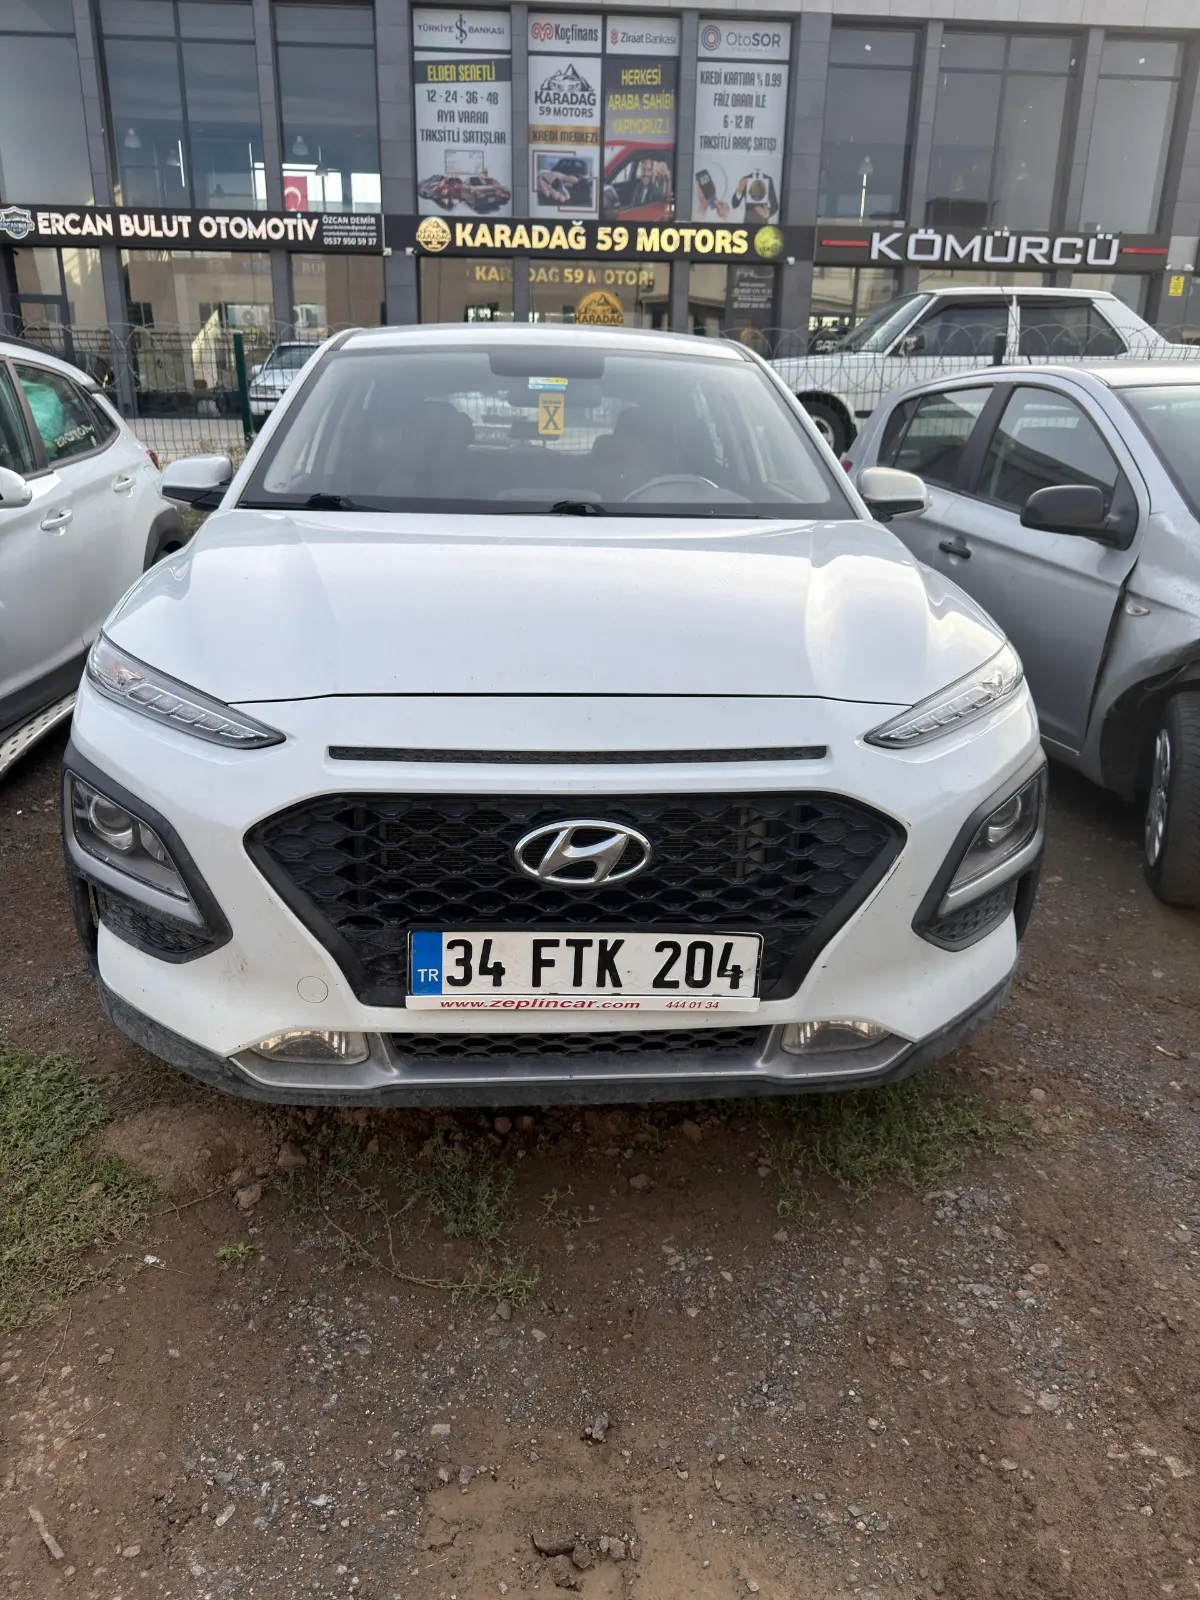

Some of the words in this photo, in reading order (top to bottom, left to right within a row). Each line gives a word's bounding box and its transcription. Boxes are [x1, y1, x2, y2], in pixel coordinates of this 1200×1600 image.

[417, 23, 454, 33] TÜRKİYE
[468, 27, 505, 35] BANKASI
[554, 23, 599, 43] Koçfinans
[620, 33, 644, 44] Ziraat
[645, 33, 676, 44] Bankası
[726, 32, 781, 47] OtoSOR
[427, 65, 456, 81] ELDEN
[621, 64, 662, 86] HERKESİ
[700, 68, 722, 85] KREDİ
[765, 72, 782, 87] 0.99
[426, 89, 437, 103] 12
[445, 90, 458, 103] 24
[466, 91, 478, 104] 36
[486, 92, 499, 105] 48
[608, 94, 640, 110] ARABA
[642, 89, 675, 110] SAHİBİ
[437, 109, 455, 123] AYA
[458, 110, 489, 124] VARAN
[539, 106, 551, 116] 59
[553, 107, 594, 118] MOTORS
[723, 114, 729, 128] 6
[735, 115, 743, 128] 12
[744, 115, 755, 129] AY
[420, 127, 460, 143] TAKSİTLİ
[462, 130, 506, 146] SATIŞLAR
[36, 212, 114, 236] ERCAN
[120, 214, 192, 239] BULUT
[199, 212, 319, 241] OTOMOTİV
[322, 214, 348, 224] ÖZCAN
[350, 215, 376, 225] DEMİR
[323, 236, 341, 245] 0537
[455, 220, 587, 252] KARADAĞ
[596, 226, 629, 252] 59
[636, 227, 749, 254] MOTORS
[870, 228, 1120, 266] KÖMÜRCÜ
[563, 267, 584, 283] 59
[542, 405, 561, 431] X
[446, 939, 506, 987] 34
[532, 938, 625, 987] FTK
[652, 940, 744, 989] 204
[417, 968, 439, 982] TR
[440, 998, 641, 1010] www.zeplincar.com
[666, 1001, 686, 1009] 444
[688, 1001, 702, 1009] 01
[705, 1001, 719, 1009] 34
